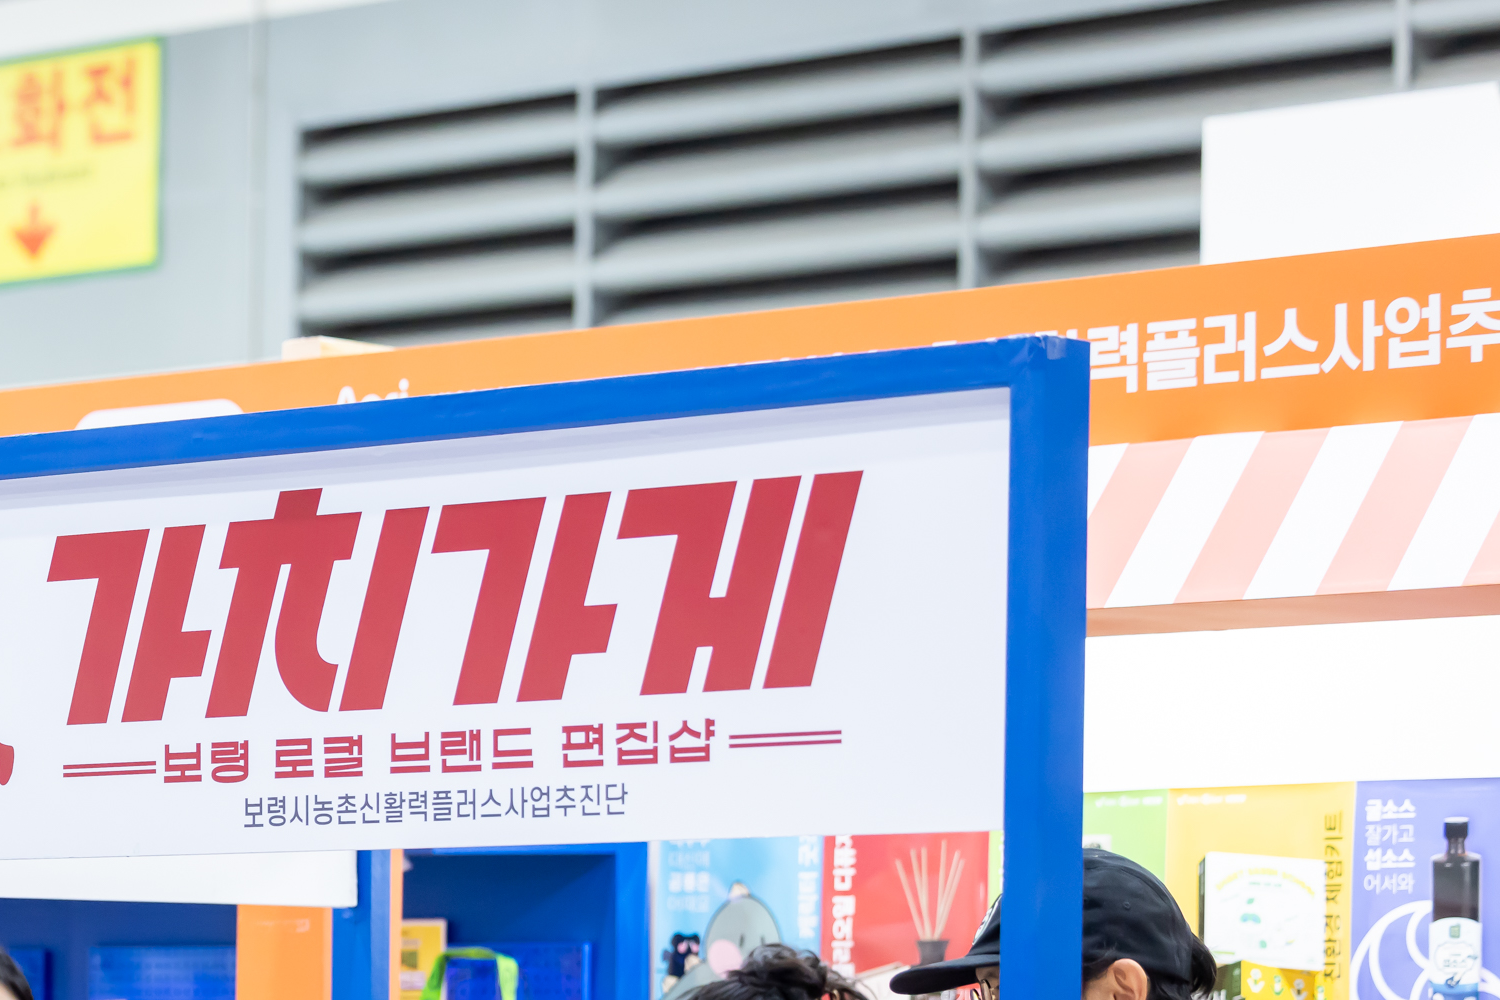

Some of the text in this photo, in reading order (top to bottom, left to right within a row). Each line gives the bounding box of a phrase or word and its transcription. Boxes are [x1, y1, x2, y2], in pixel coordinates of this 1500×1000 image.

[1090, 286, 1500, 394] 력플러스사업추
[46, 469, 864, 725] 가치가게
[162, 716, 717, 786] 보령 로컬 브랜드 편집샵
[242, 782, 630, 831] 보령시농촌신활력플러스사업추진단
[1364, 800, 1416, 820] 굴소스
[1364, 823, 1415, 844] 잘가고
[1364, 873, 1414, 894] 어서와
